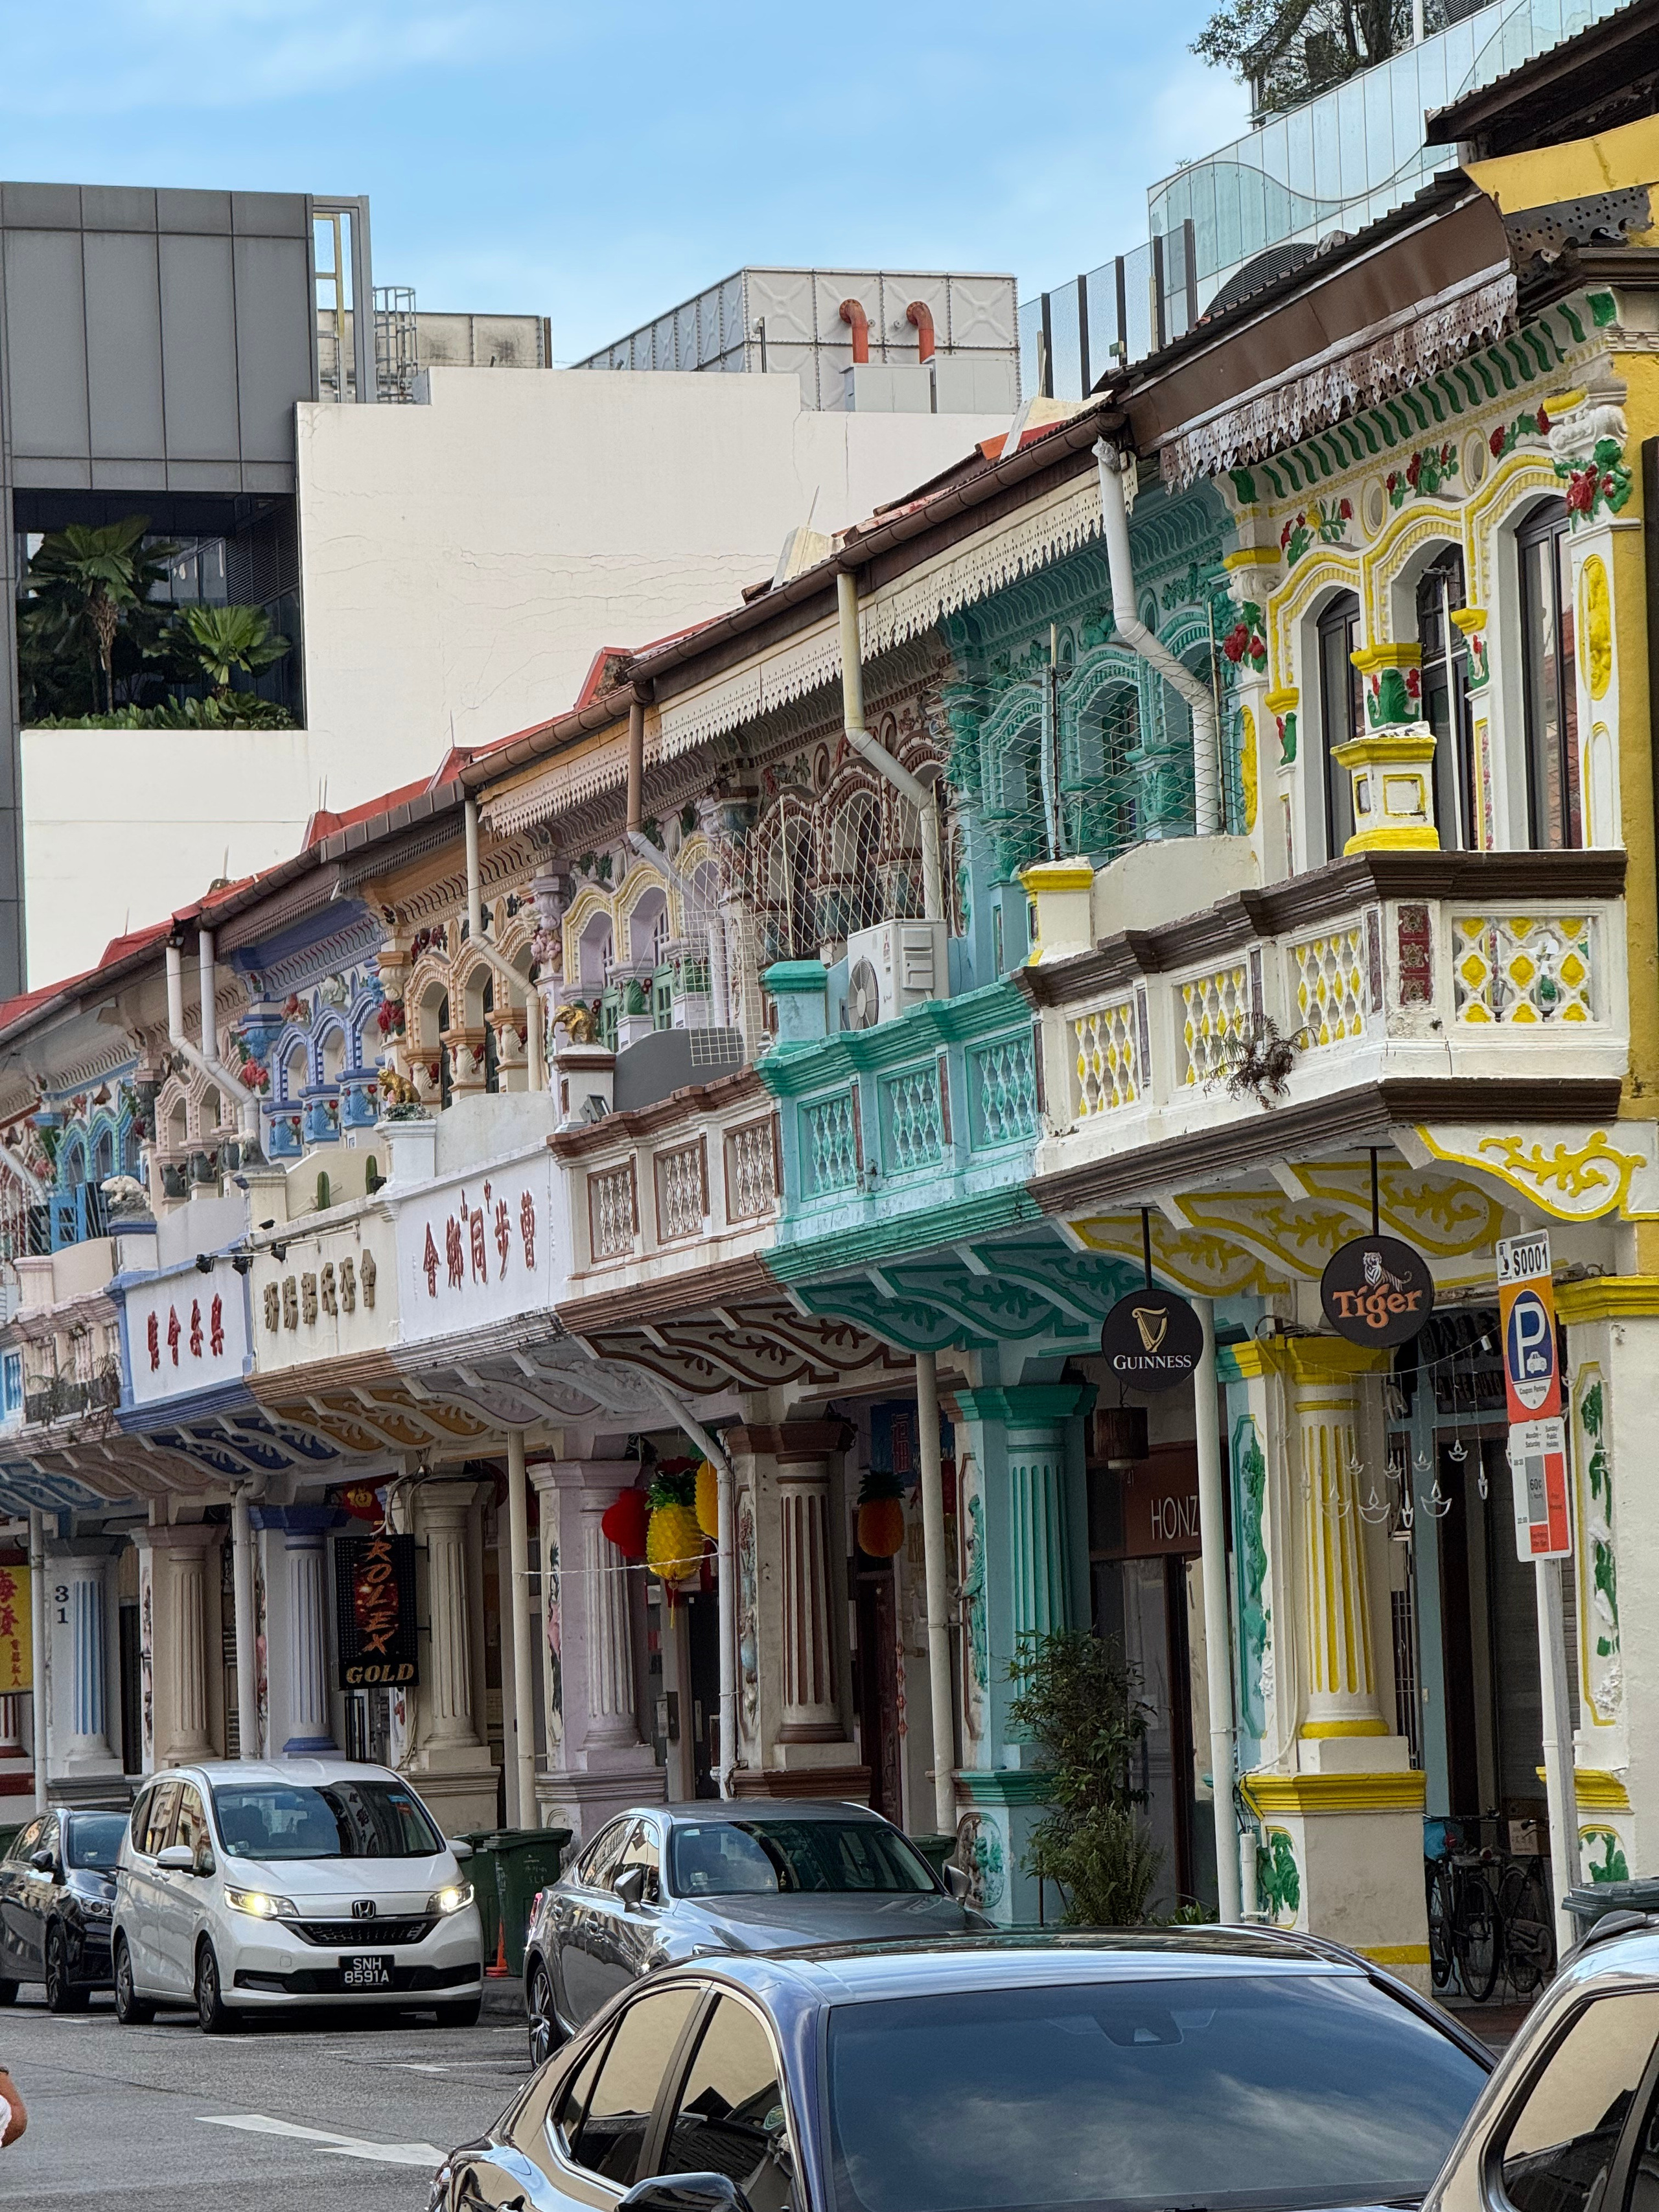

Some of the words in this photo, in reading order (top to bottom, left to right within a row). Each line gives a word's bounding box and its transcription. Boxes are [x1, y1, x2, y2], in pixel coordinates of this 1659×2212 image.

[1513, 1242, 1548, 1276] S0001
[1332, 1283, 1423, 1329] Tiger
[1514, 1301, 1546, 1379] P
[1113, 1355, 1192, 1370] GUINNESS
[1151, 1495, 1199, 1540] HONZ
[361, 1537, 397, 1656] ROLEX
[345, 1663, 415, 1684] GOLD
[344, 1970, 389, 1984] 8591A
[353, 1957, 382, 1970] SNH
